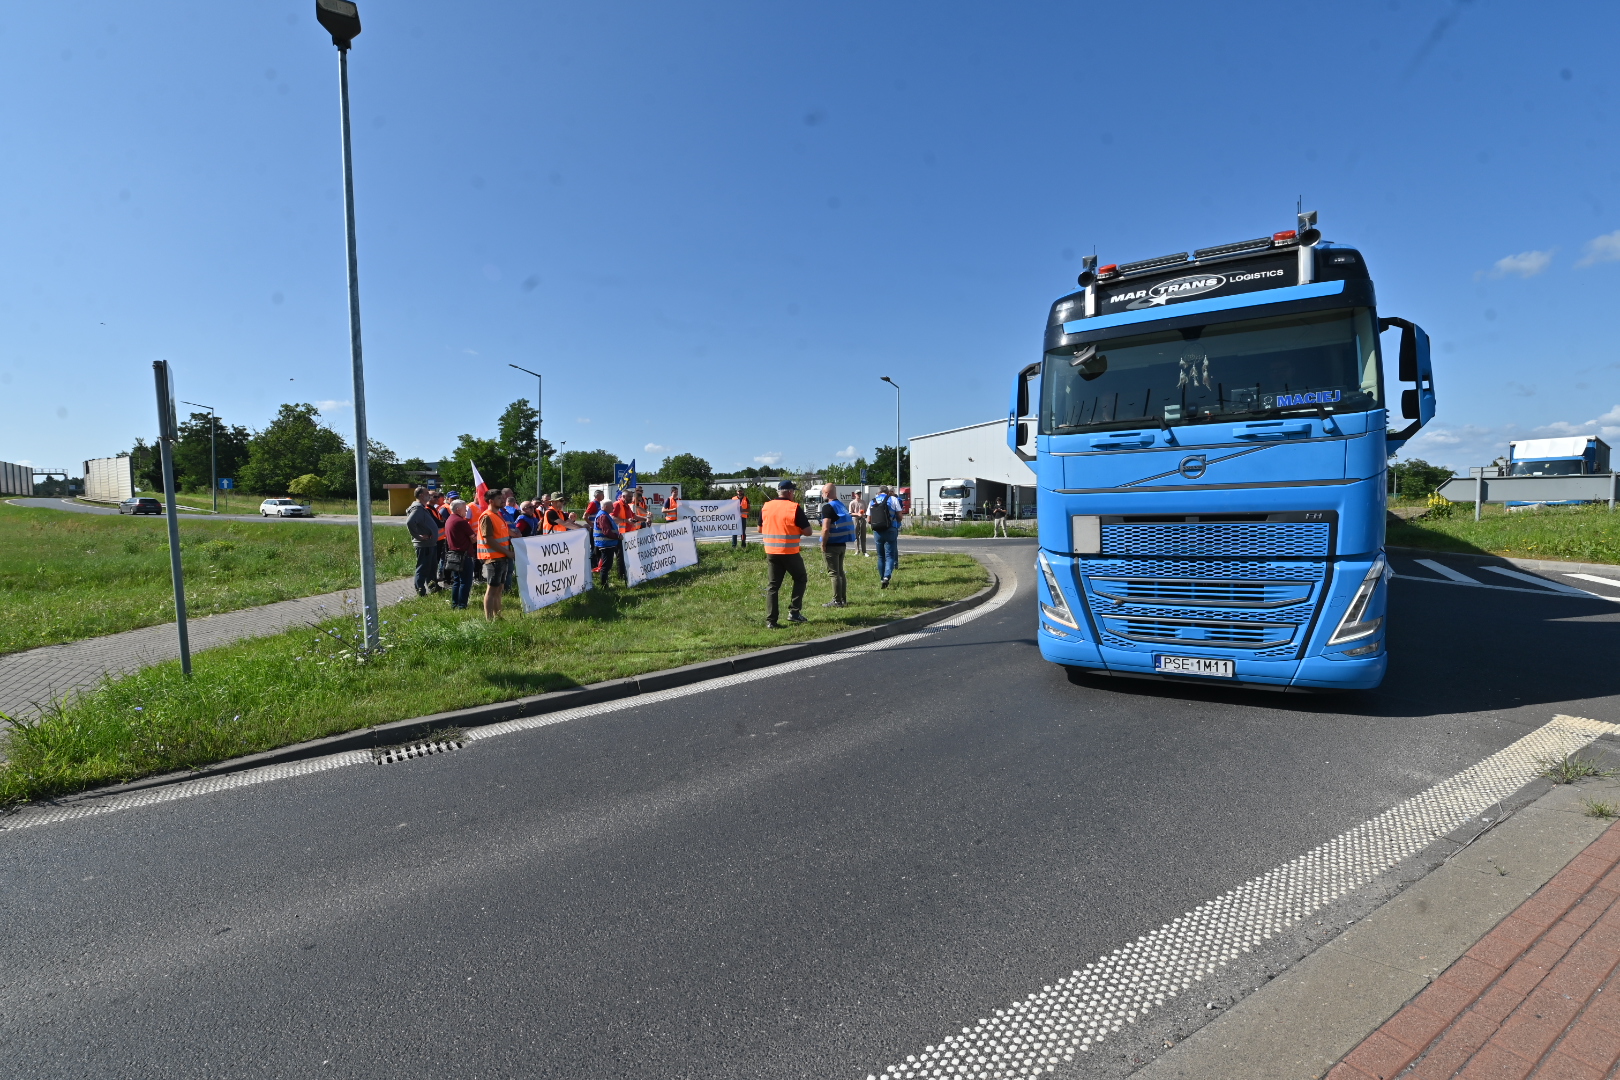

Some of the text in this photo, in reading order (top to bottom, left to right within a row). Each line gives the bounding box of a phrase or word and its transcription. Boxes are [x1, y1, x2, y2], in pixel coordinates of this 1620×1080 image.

[1110, 269, 1284, 304] MAR TRANS LOGISTICS
[1277, 390, 1341, 407] MACIEJ
[700, 505, 719, 513] STOP
[717, 523, 738, 531] KOLEI
[541, 541, 570, 557] WOLĄ
[637, 543, 674, 561] TRANSPORTU
[537, 558, 573, 577] SPALINY
[640, 555, 677, 576] DROGOWEGO
[535, 573, 578, 597] NIŻ SZYNY
[1164, 657, 1190, 670] PSE
